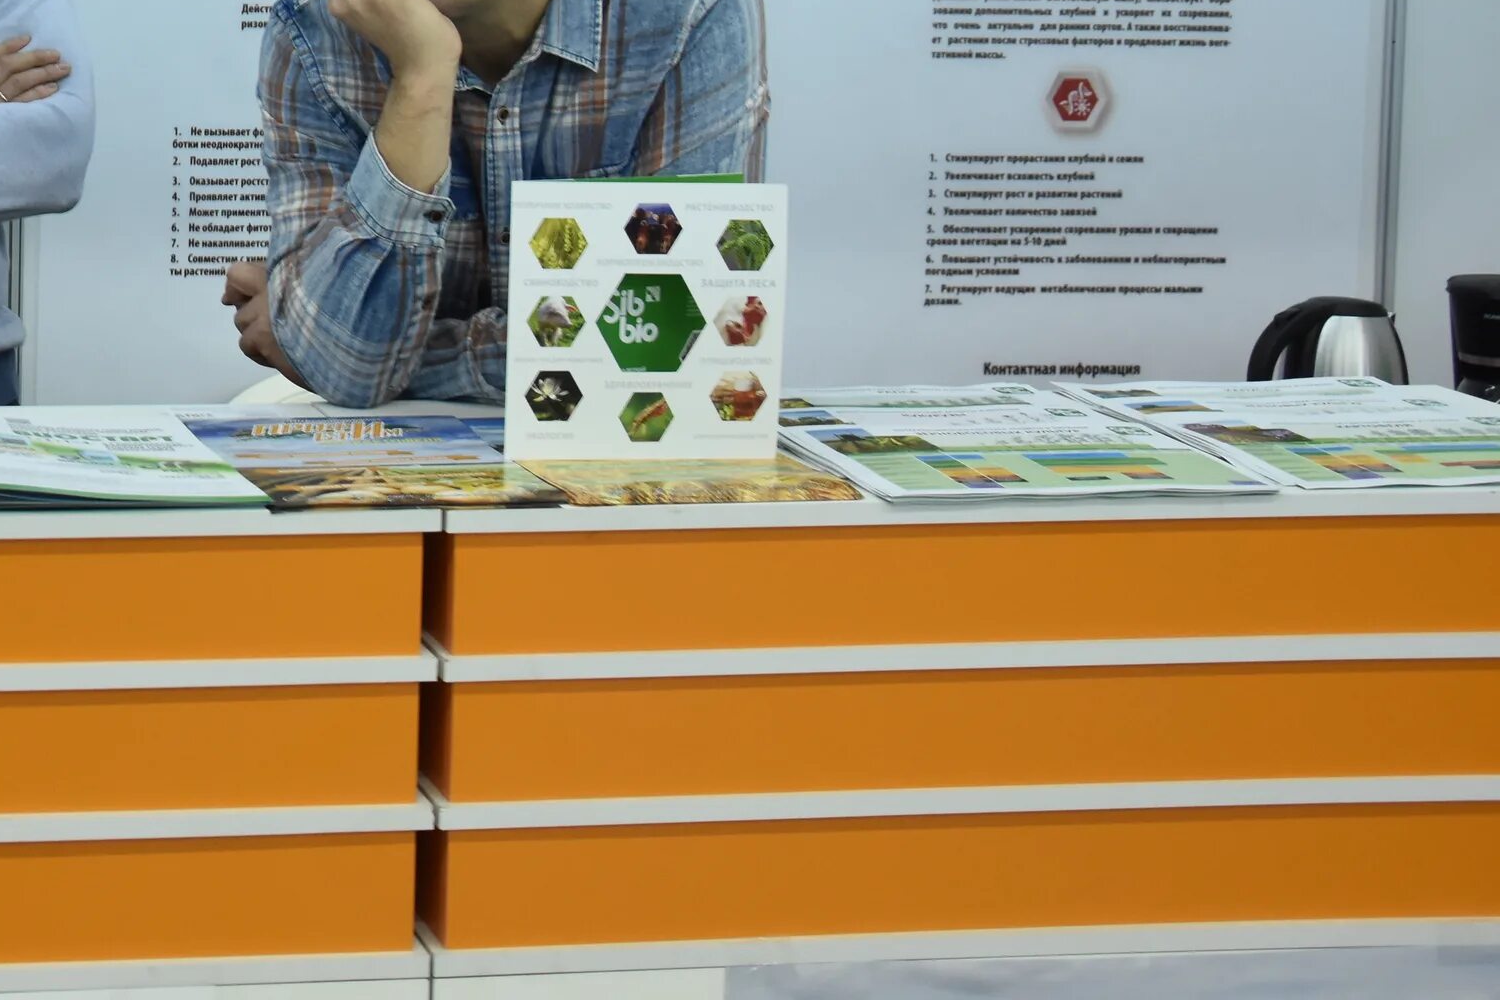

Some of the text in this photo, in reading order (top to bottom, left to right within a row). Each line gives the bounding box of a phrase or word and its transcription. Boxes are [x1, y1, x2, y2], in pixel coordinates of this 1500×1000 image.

[618, 317, 659, 344] bio
[982, 362, 1141, 378] Контактная информация
